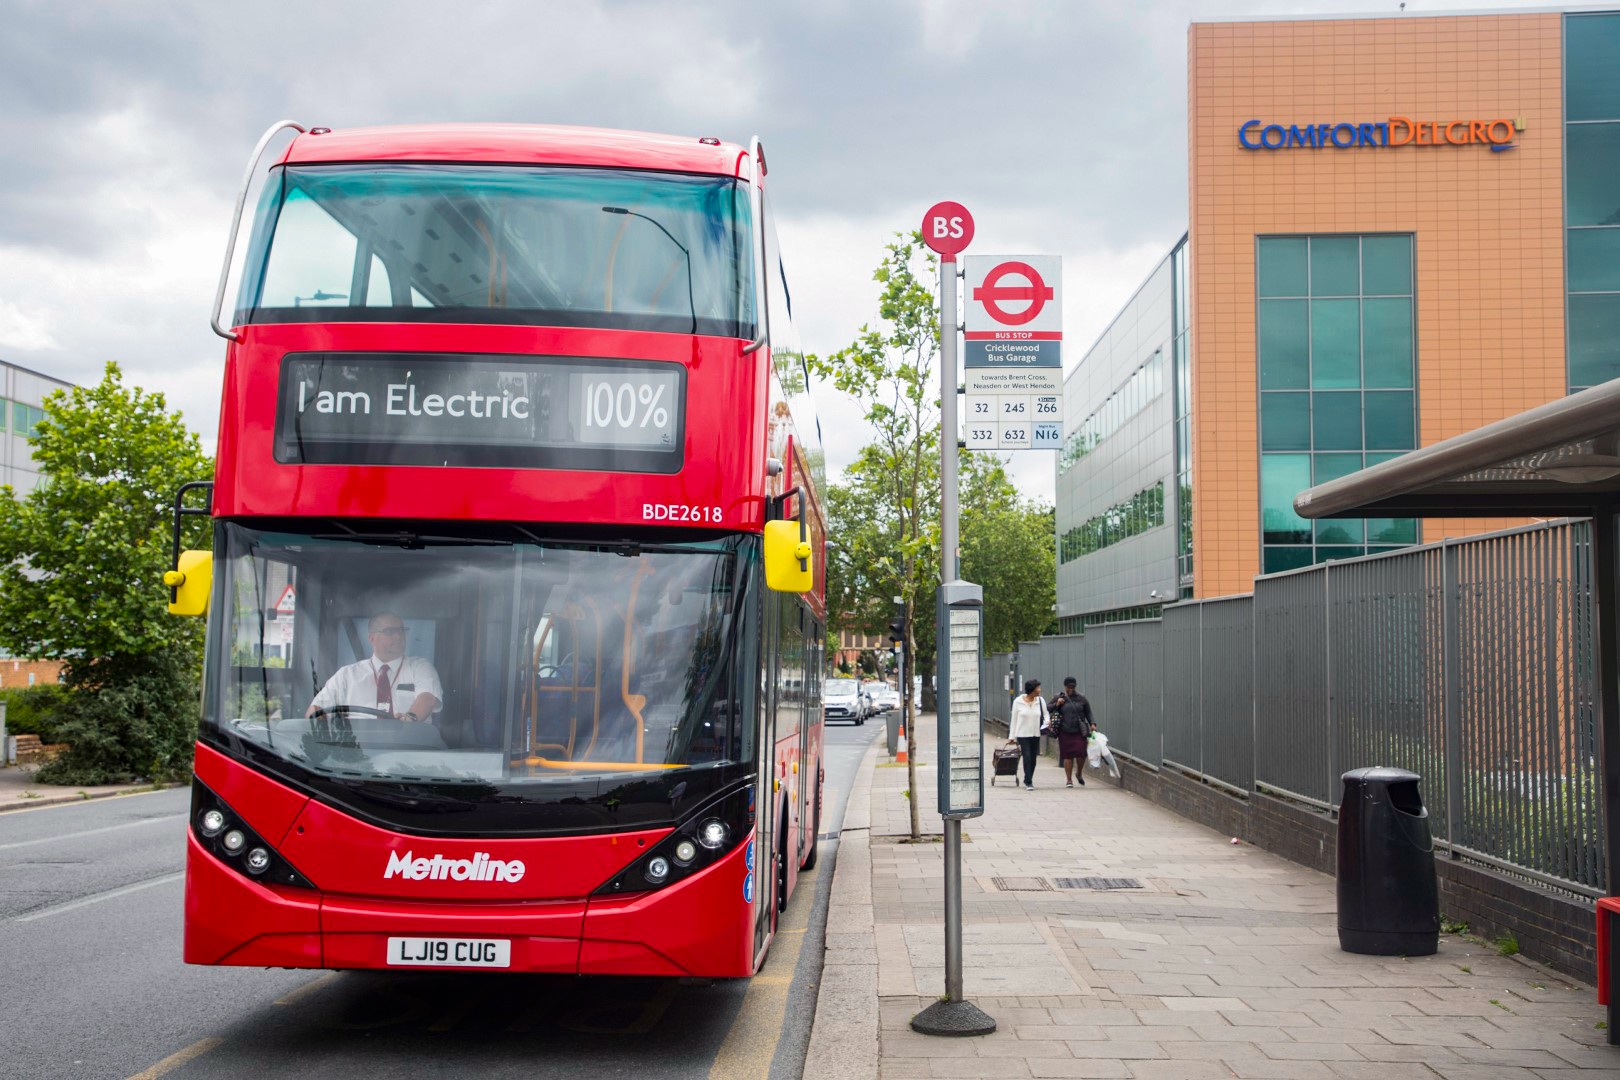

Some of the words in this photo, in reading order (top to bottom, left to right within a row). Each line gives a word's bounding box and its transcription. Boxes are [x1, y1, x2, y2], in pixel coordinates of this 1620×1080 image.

[933, 216, 964, 239] BS
[985, 344, 1040, 352] Cricklewood
[988, 354, 1004, 362] Bus
[1006, 354, 1037, 363] Garage
[298, 381, 306, 412] I
[316, 390, 371, 414] am
[386, 383, 529, 419] Electric
[586, 382, 668, 429] 100%
[975, 403, 989, 413] 32
[1005, 403, 1025, 413] 245
[1037, 403, 1057, 413] 266
[972, 430, 992, 440] 332
[1005, 430, 1025, 440] 632
[1035, 430, 1059, 440] N16
[642, 504, 723, 523] BDE2618
[383, 850, 526, 883] Metroline
[401, 941, 448, 961] LJ19
[455, 943, 496, 962] CUG
